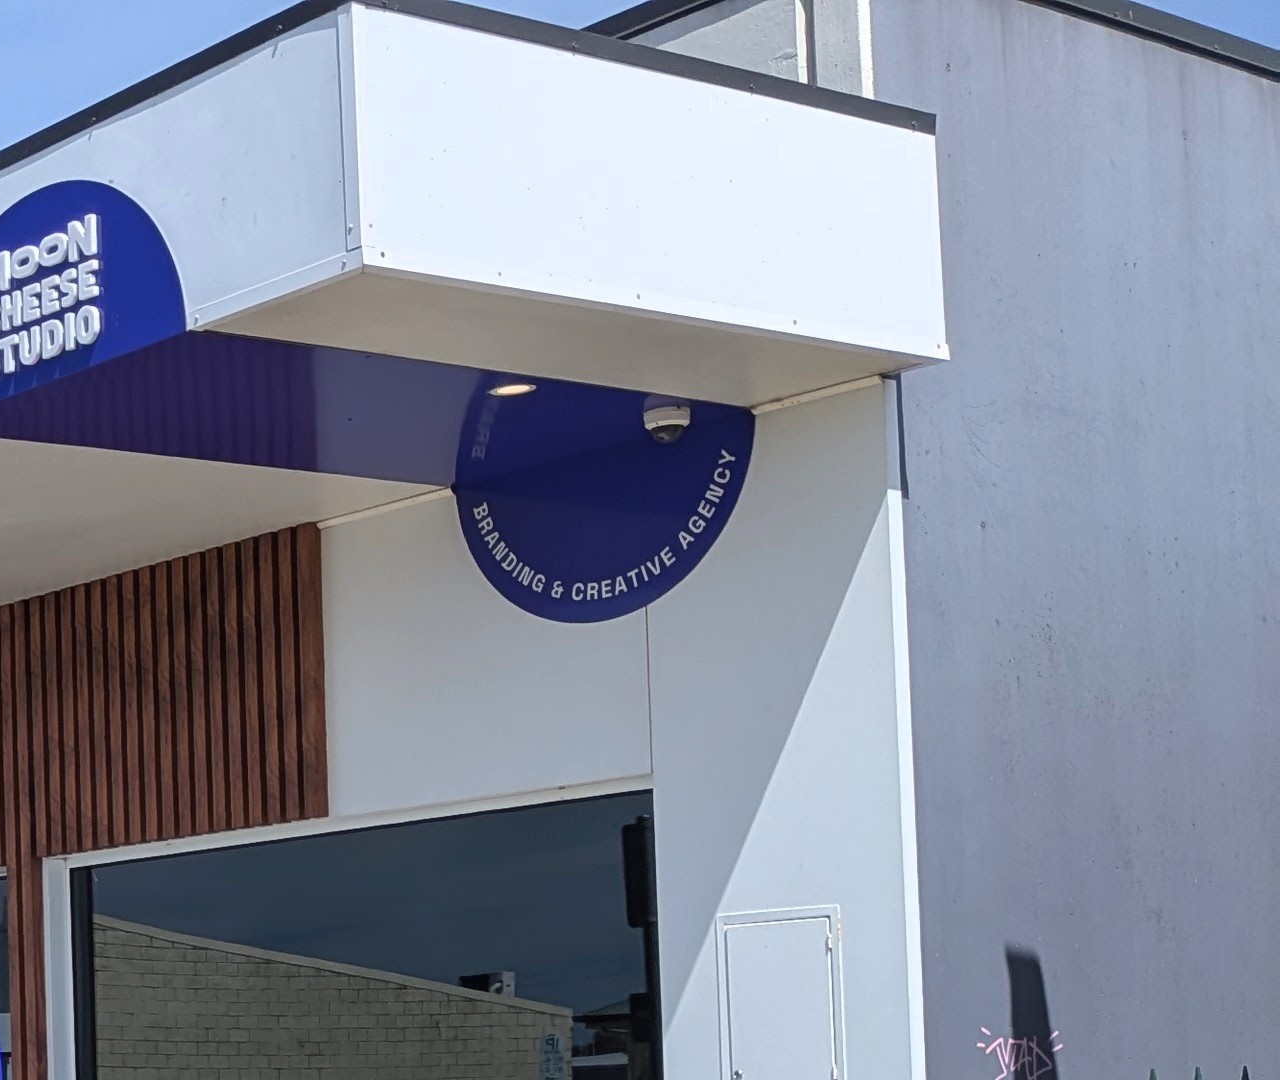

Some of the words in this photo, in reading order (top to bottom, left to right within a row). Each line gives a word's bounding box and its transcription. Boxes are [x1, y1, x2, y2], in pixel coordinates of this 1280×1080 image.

[473, 502, 546, 593] BRANDING
[551, 581, 564, 598] &
[572, 545, 676, 601] CREATIVE
[678, 449, 737, 549] AGENCY
